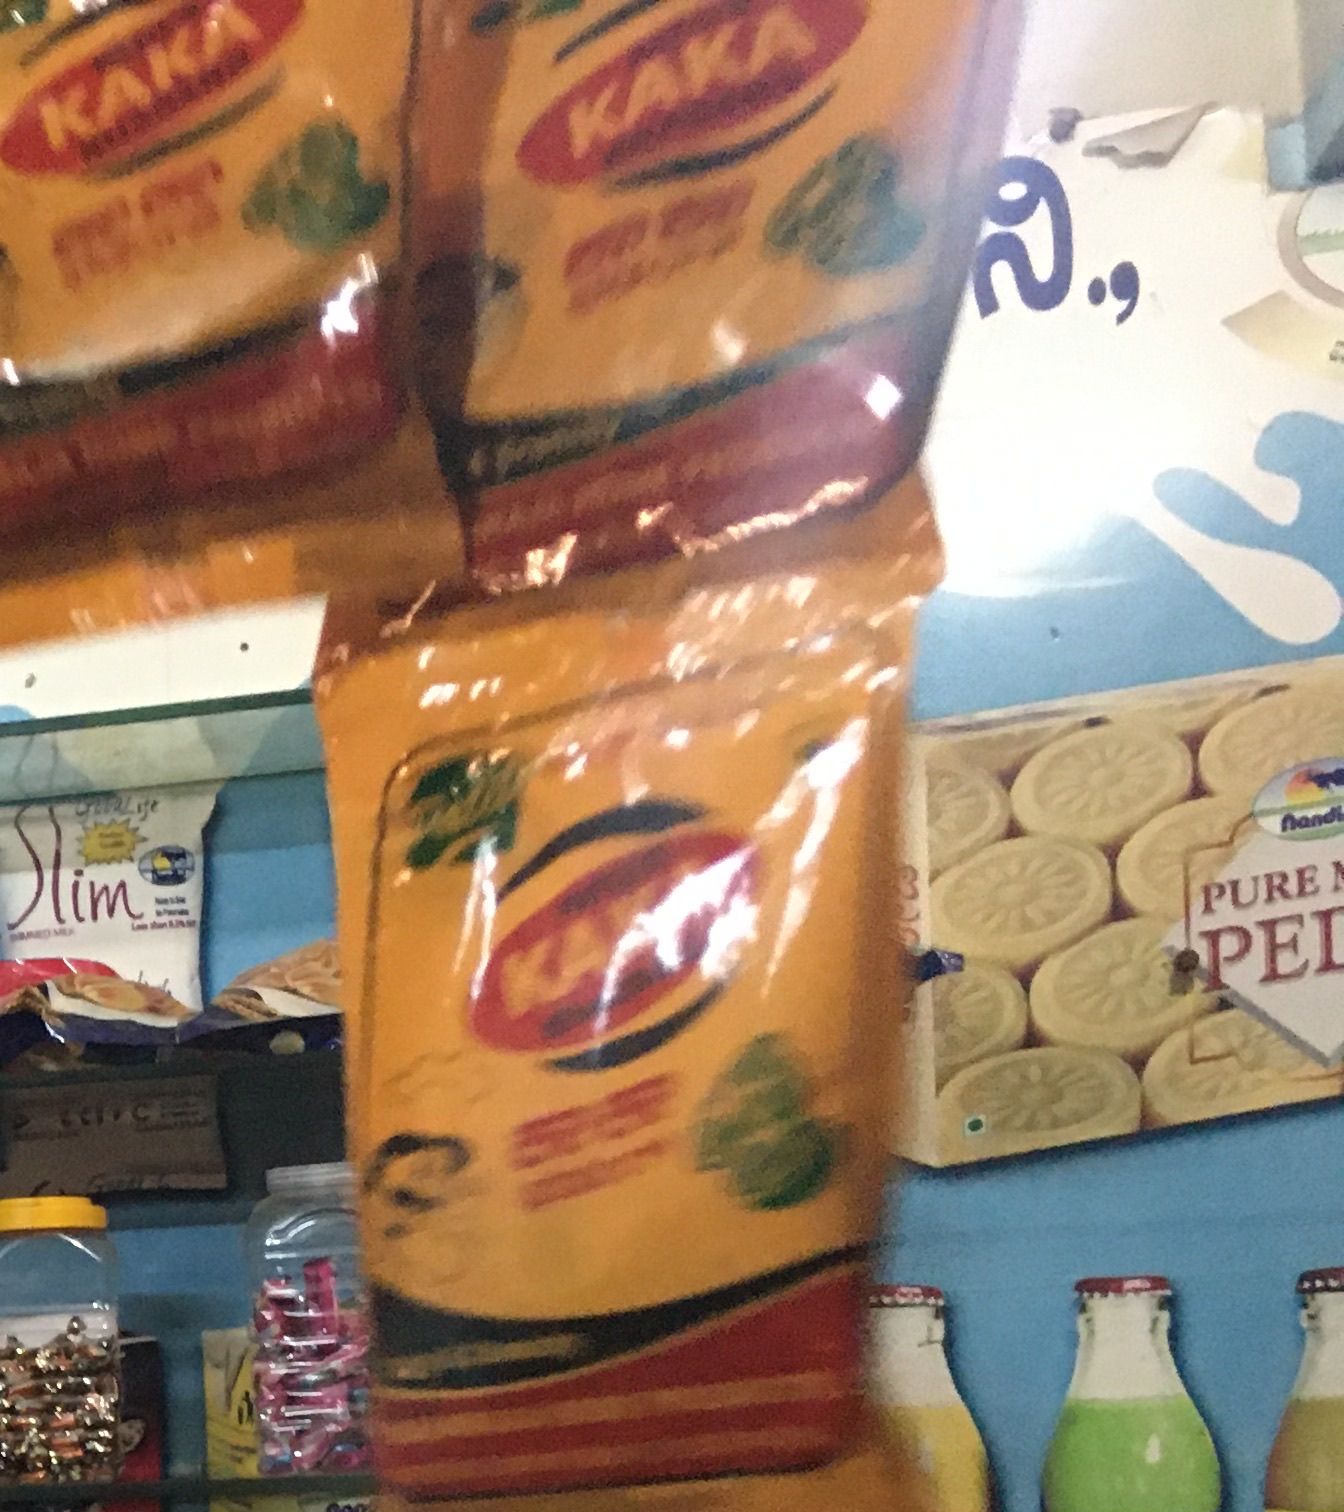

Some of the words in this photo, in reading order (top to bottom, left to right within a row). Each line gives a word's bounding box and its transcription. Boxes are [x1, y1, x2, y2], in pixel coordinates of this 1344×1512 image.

[39, 5, 262, 151] KAKA
[569, 9, 816, 159] KAKA
[7, 805, 144, 931] Slim
[1200, 863, 1320, 915] PURE
